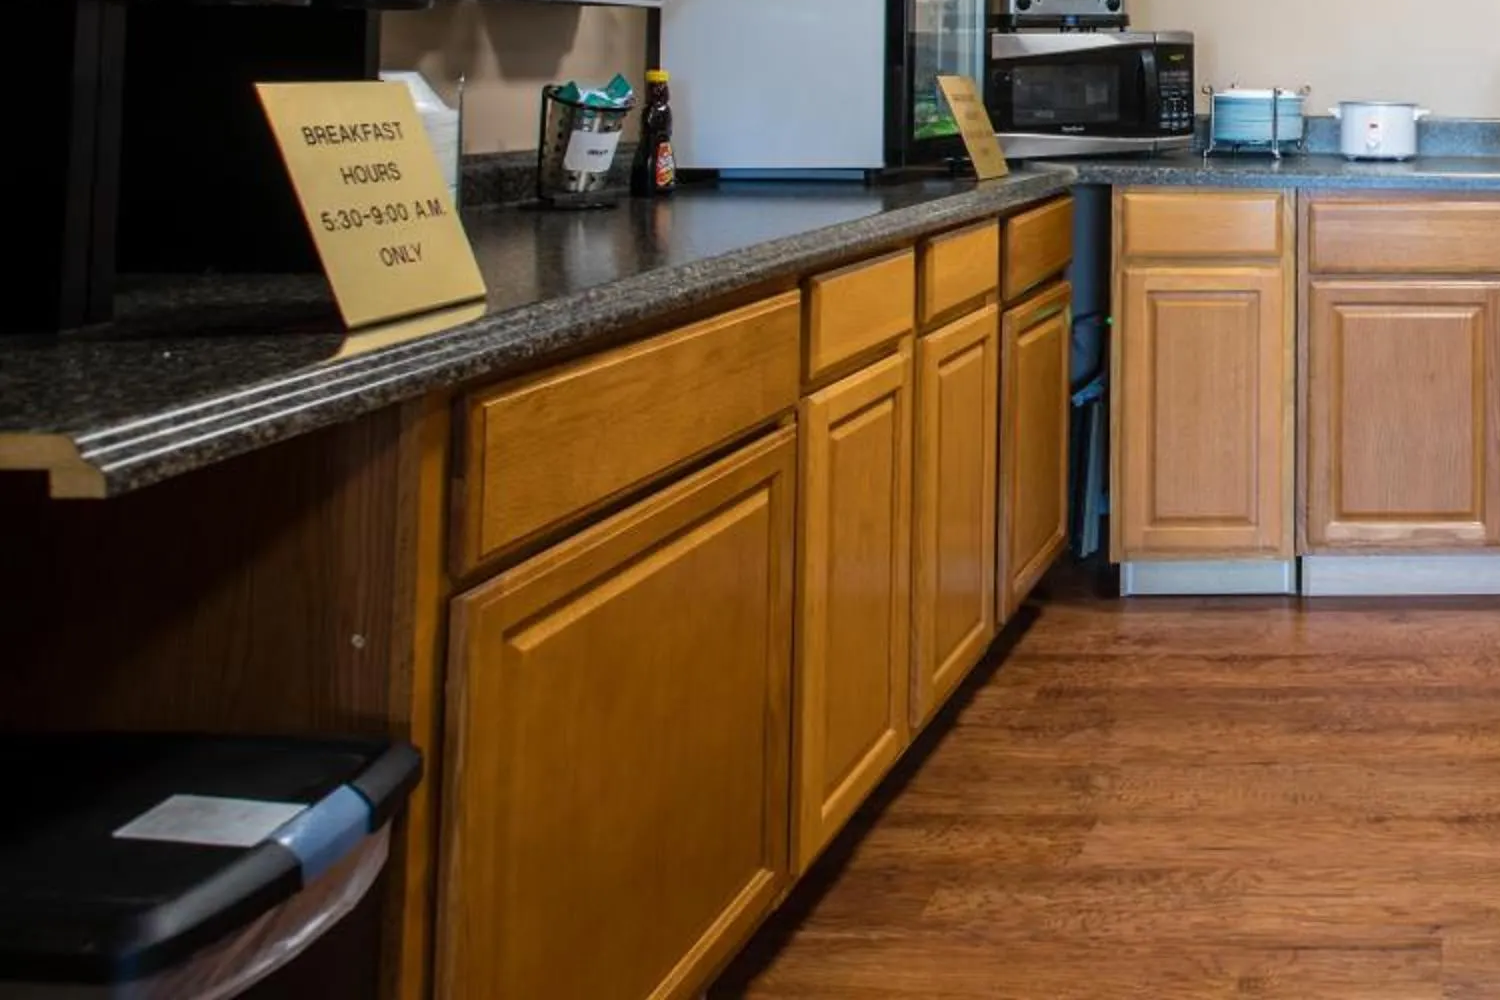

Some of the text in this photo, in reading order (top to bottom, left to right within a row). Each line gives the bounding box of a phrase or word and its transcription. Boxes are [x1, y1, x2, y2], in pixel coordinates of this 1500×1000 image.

[302, 121, 404, 146] BREAKFAST
[339, 161, 402, 185] HOURS
[320, 197, 448, 232] 5:30-9:00 A.M.
[378, 242, 423, 268] ONLY
